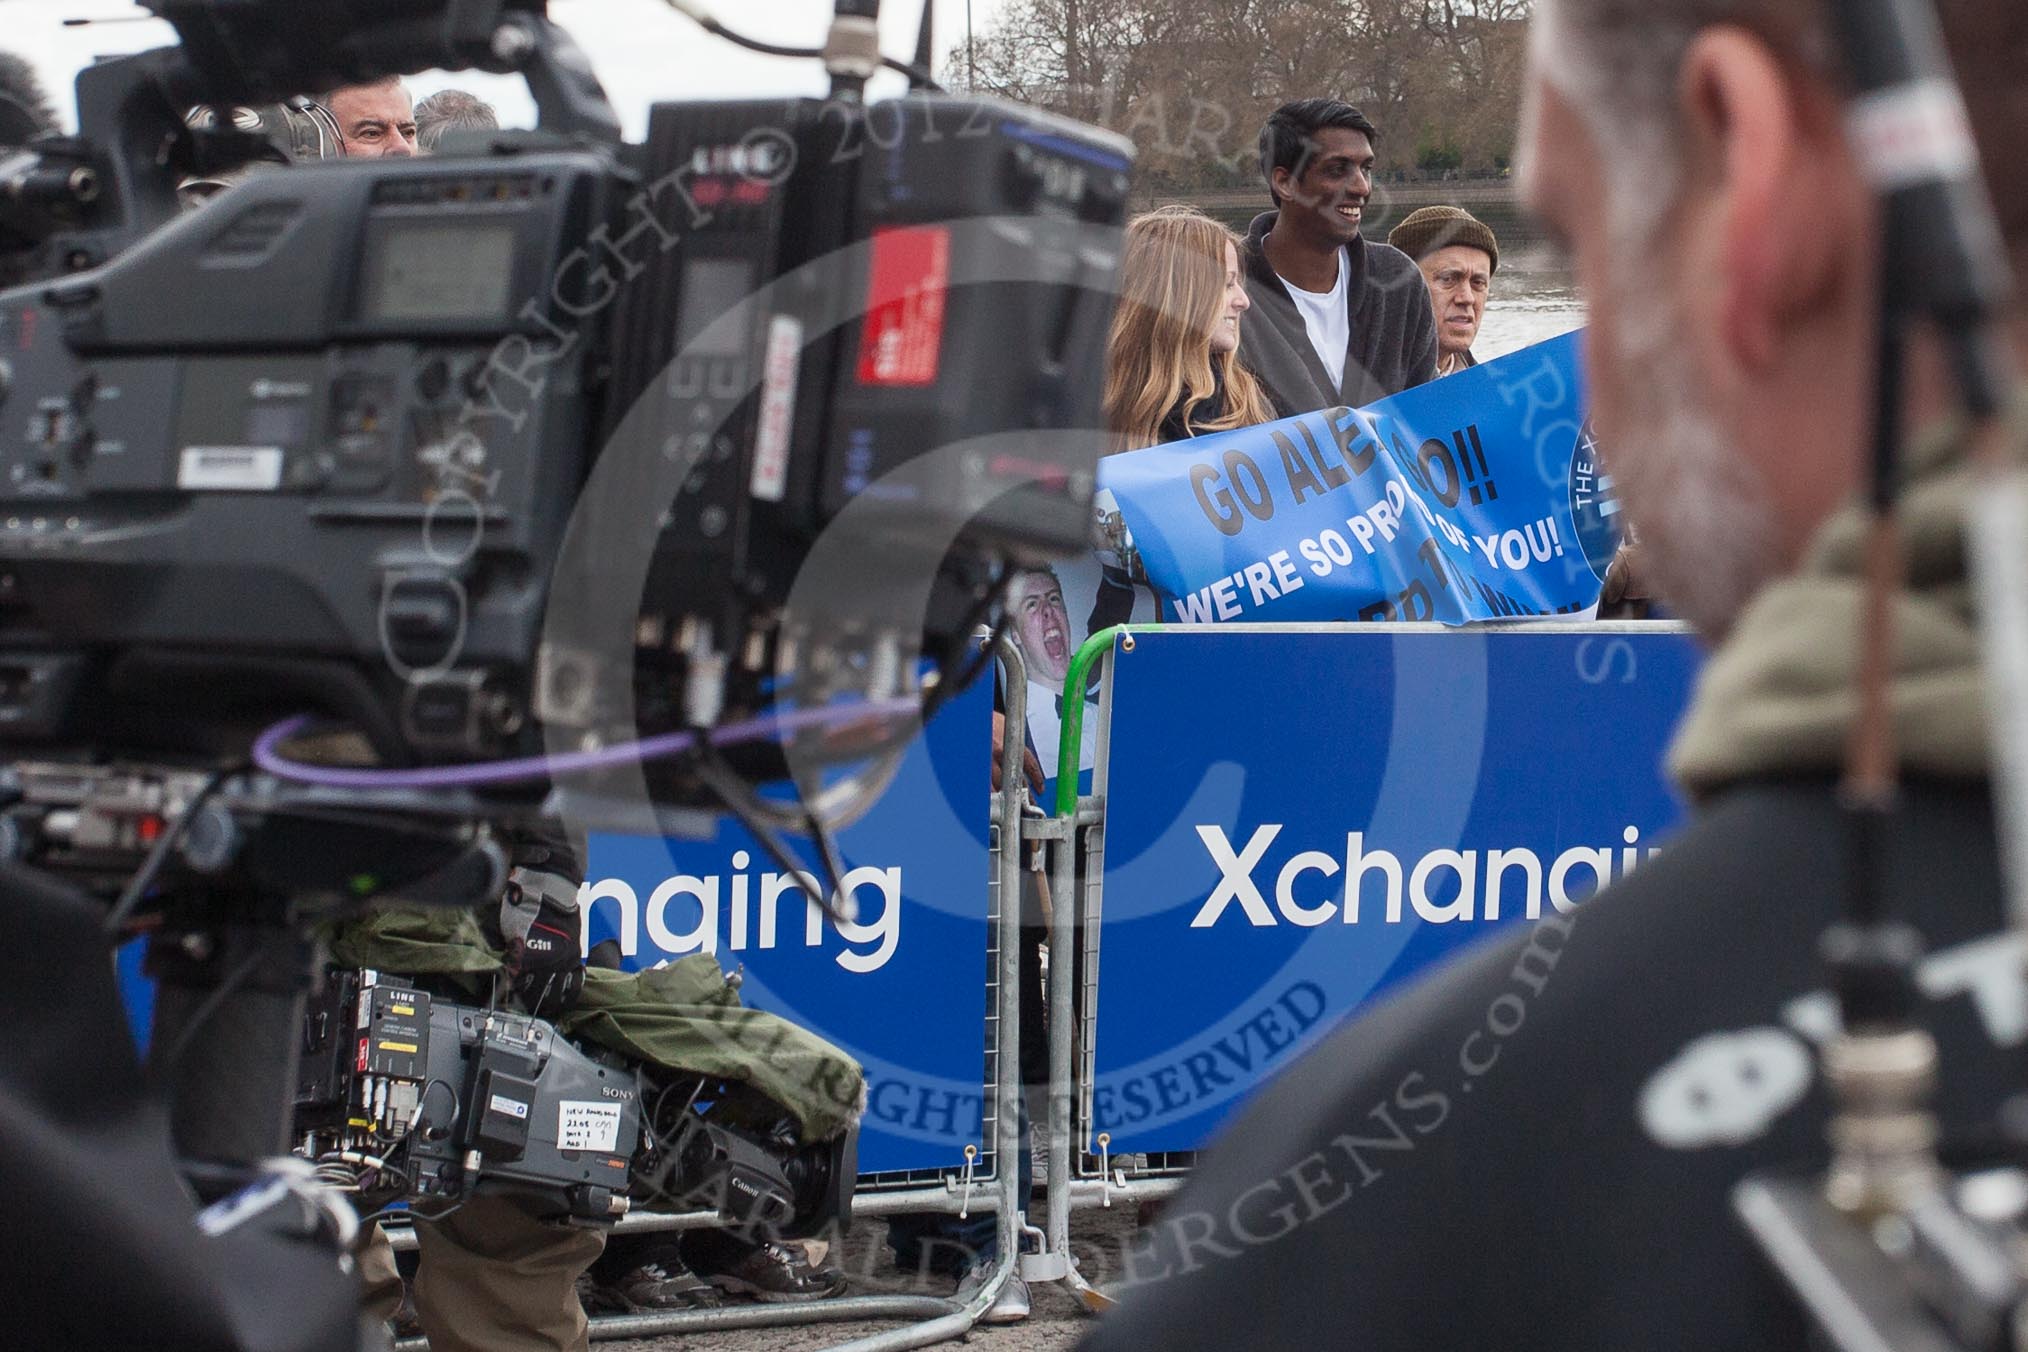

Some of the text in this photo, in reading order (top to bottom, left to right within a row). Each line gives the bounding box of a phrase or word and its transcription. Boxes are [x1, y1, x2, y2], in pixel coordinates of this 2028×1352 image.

[1190, 449, 1275, 537] GO
[1270, 406, 1385, 505] ALE
[1576, 461, 1593, 510] THE
[1173, 550, 1305, 624] WE'RE
[1299, 528, 1353, 577] SO
[1435, 513, 1471, 554] OF
[1473, 516, 1563, 571] YOU!
[1190, 824, 1663, 928] Xchangi
[526, 939, 552, 951] Gill
[390, 991, 415, 1002] LINK
[602, 1086, 634, 1100] SONY
[731, 1177, 759, 1197] Canon
